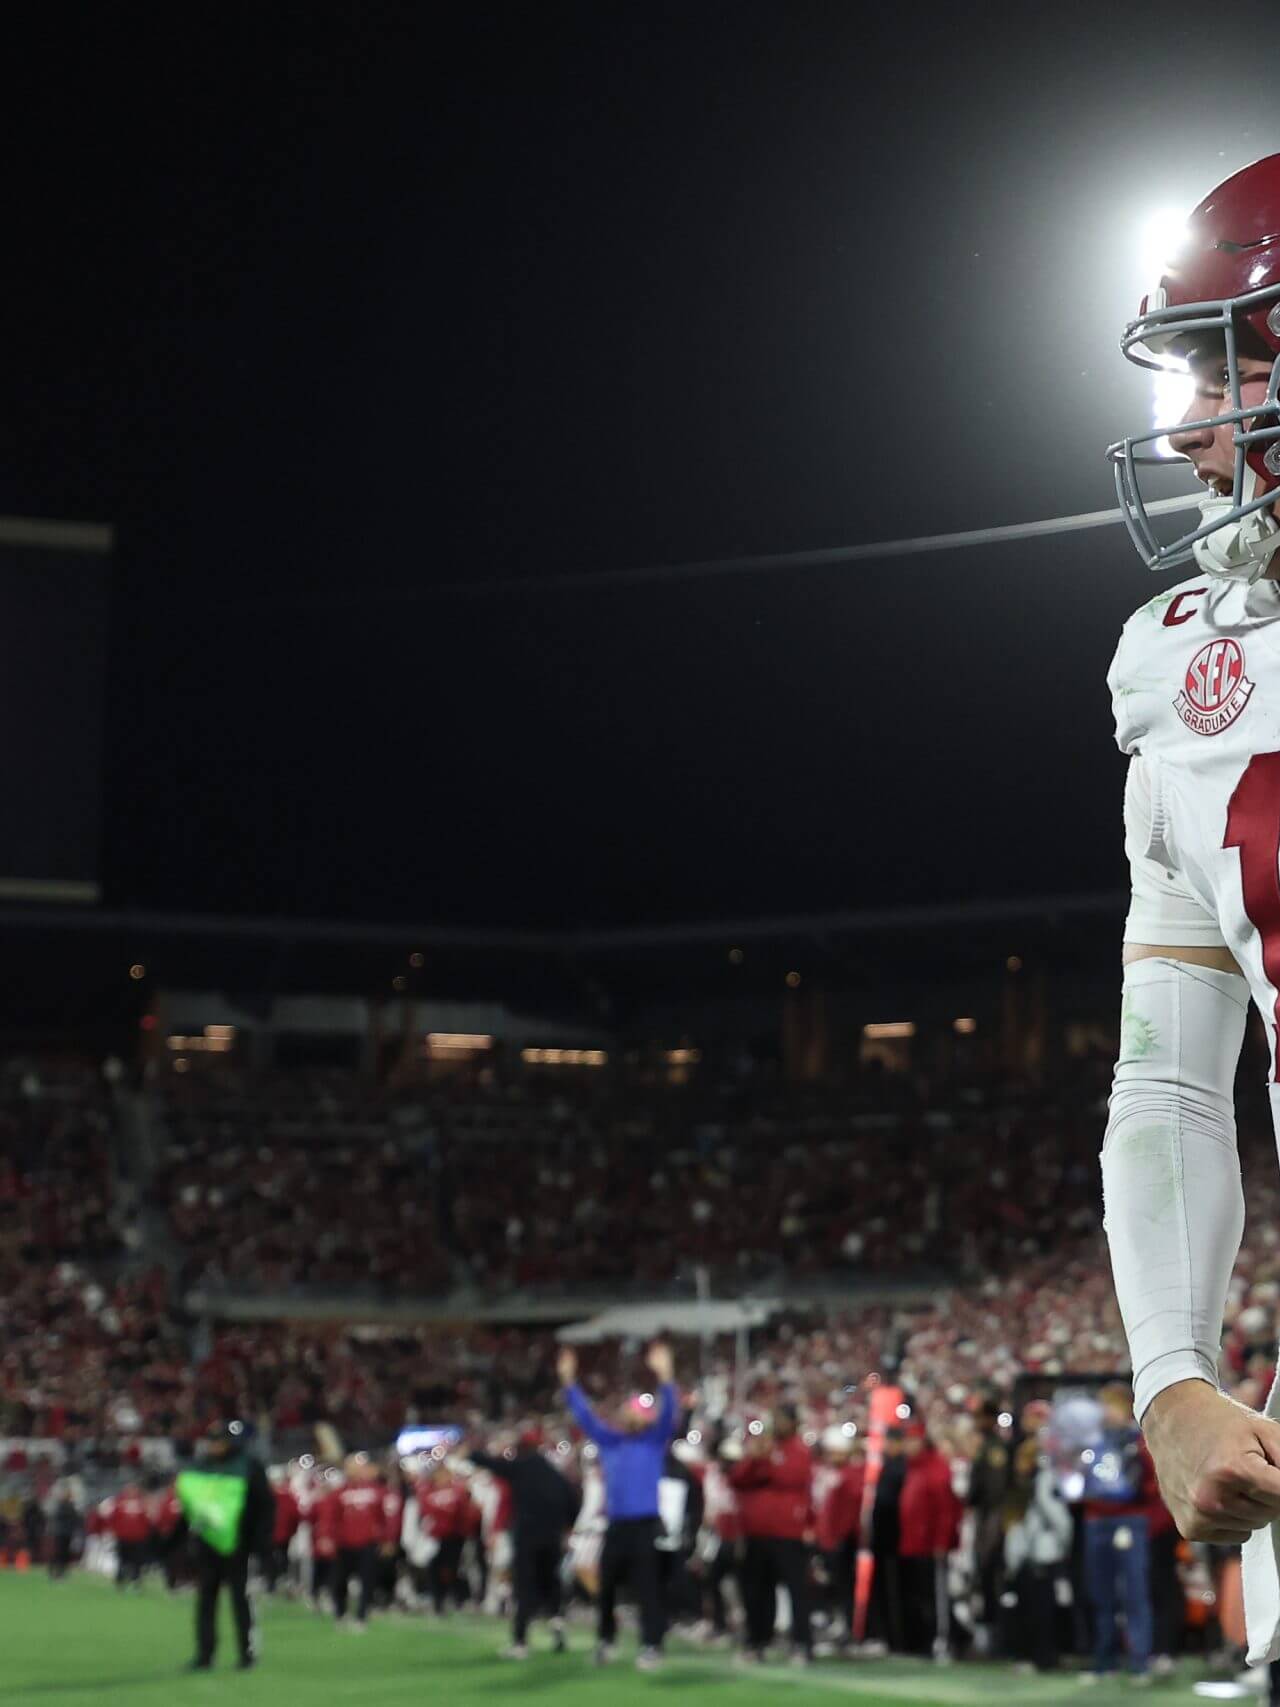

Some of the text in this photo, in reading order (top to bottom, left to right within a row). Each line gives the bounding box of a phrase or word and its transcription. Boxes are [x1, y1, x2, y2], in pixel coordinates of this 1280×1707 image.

[1162, 587, 1209, 627] C
[1190, 640, 1241, 708] SEC
[1183, 698, 1242, 735] GRADUATE
